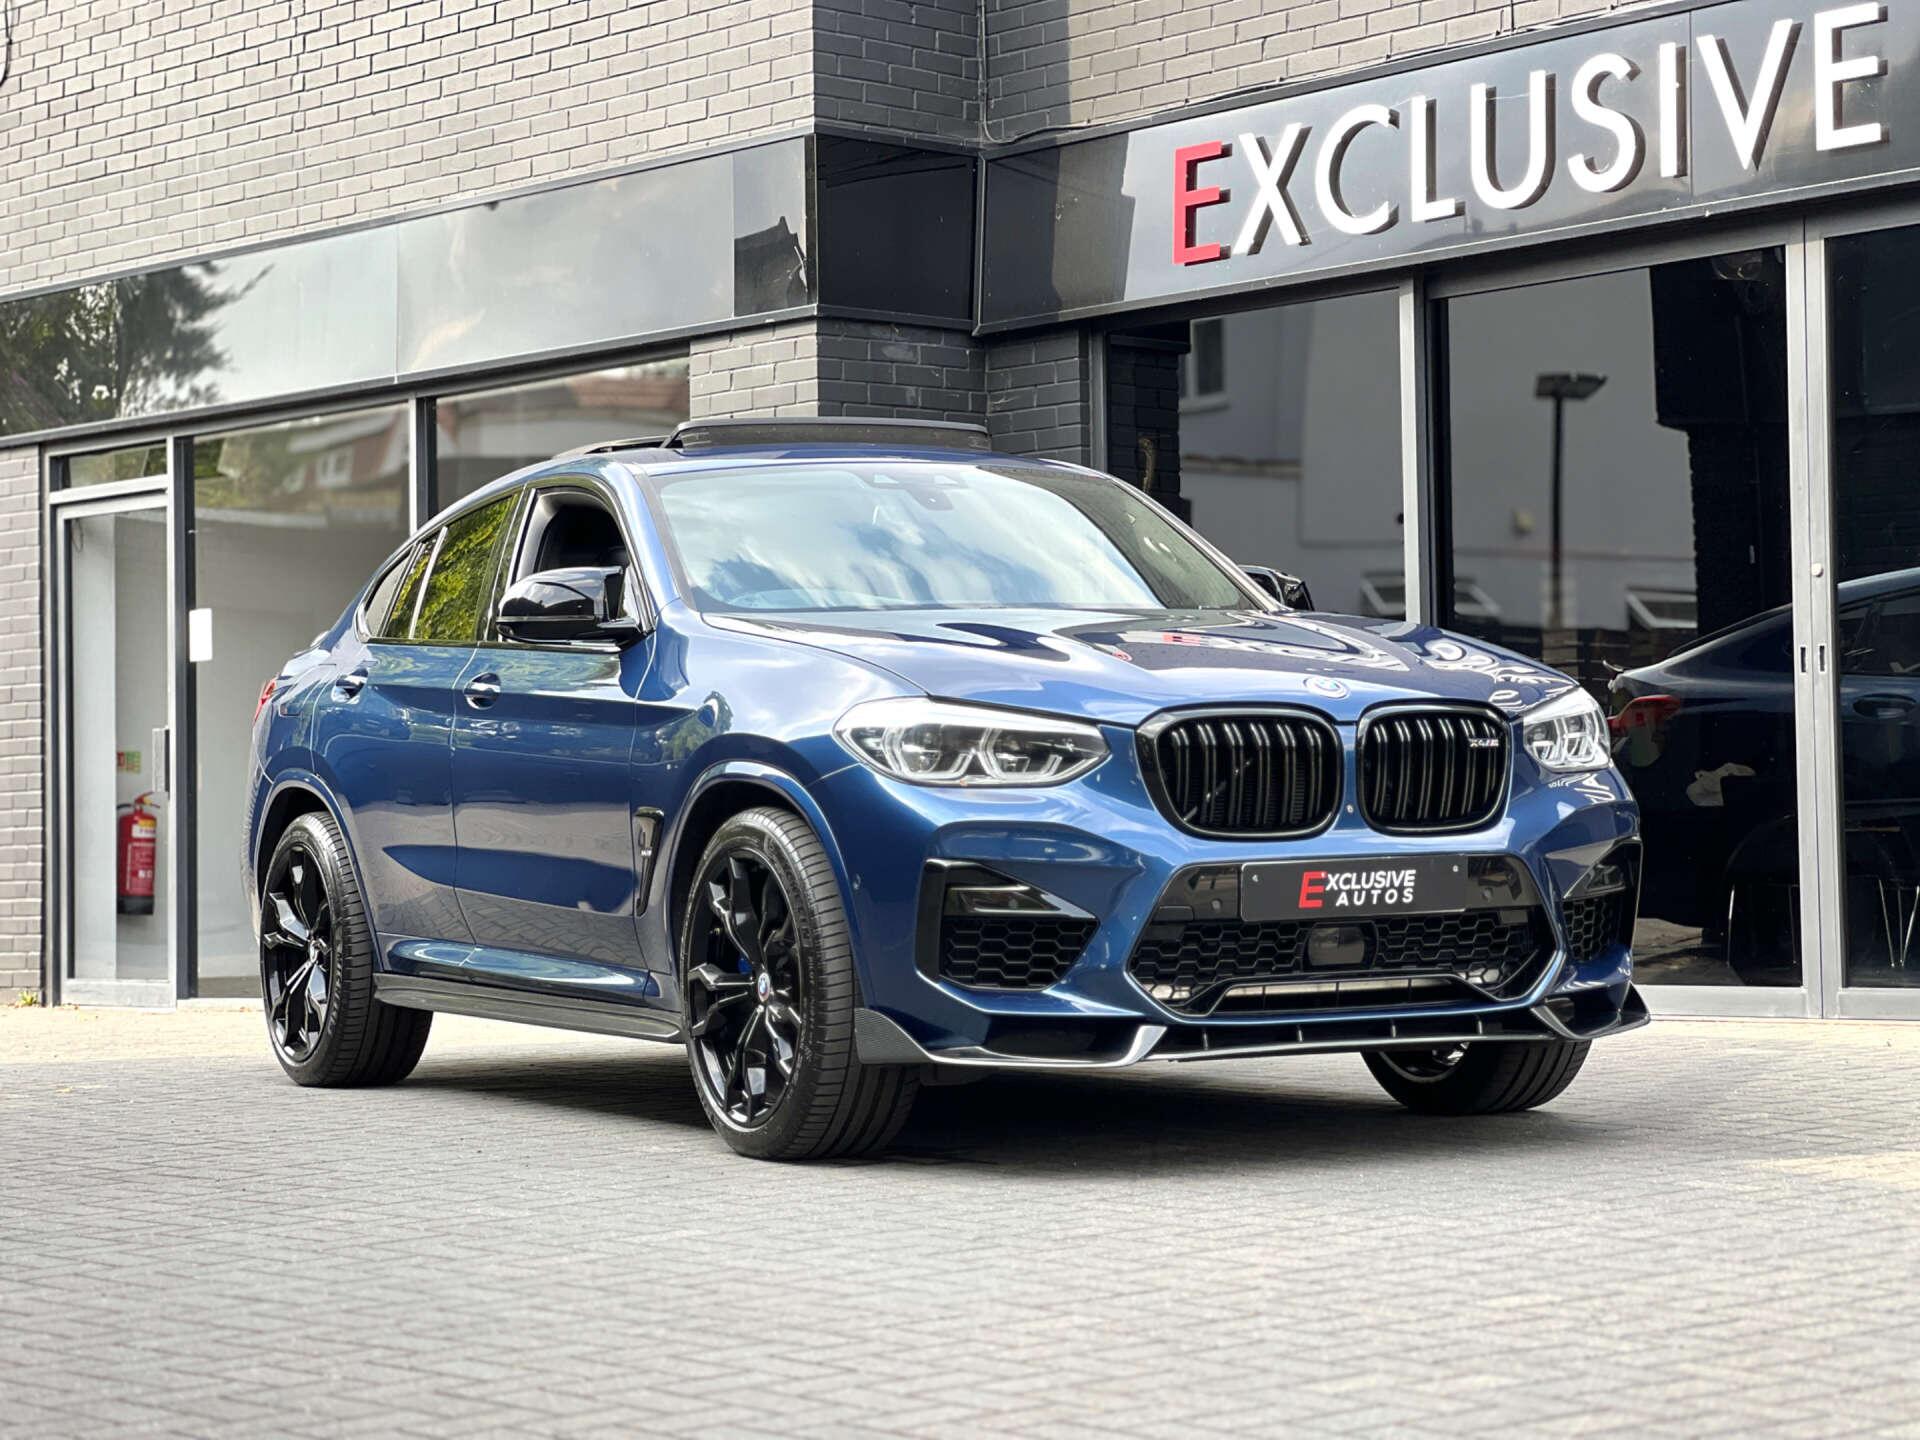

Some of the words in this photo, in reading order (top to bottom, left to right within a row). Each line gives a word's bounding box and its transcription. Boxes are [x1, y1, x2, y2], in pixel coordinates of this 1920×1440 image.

[1172, 2, 1883, 265] EXCLUSIVE
[1298, 869, 1416, 908] EXCLUSIVE
[1335, 887, 1414, 907] AUTOS
